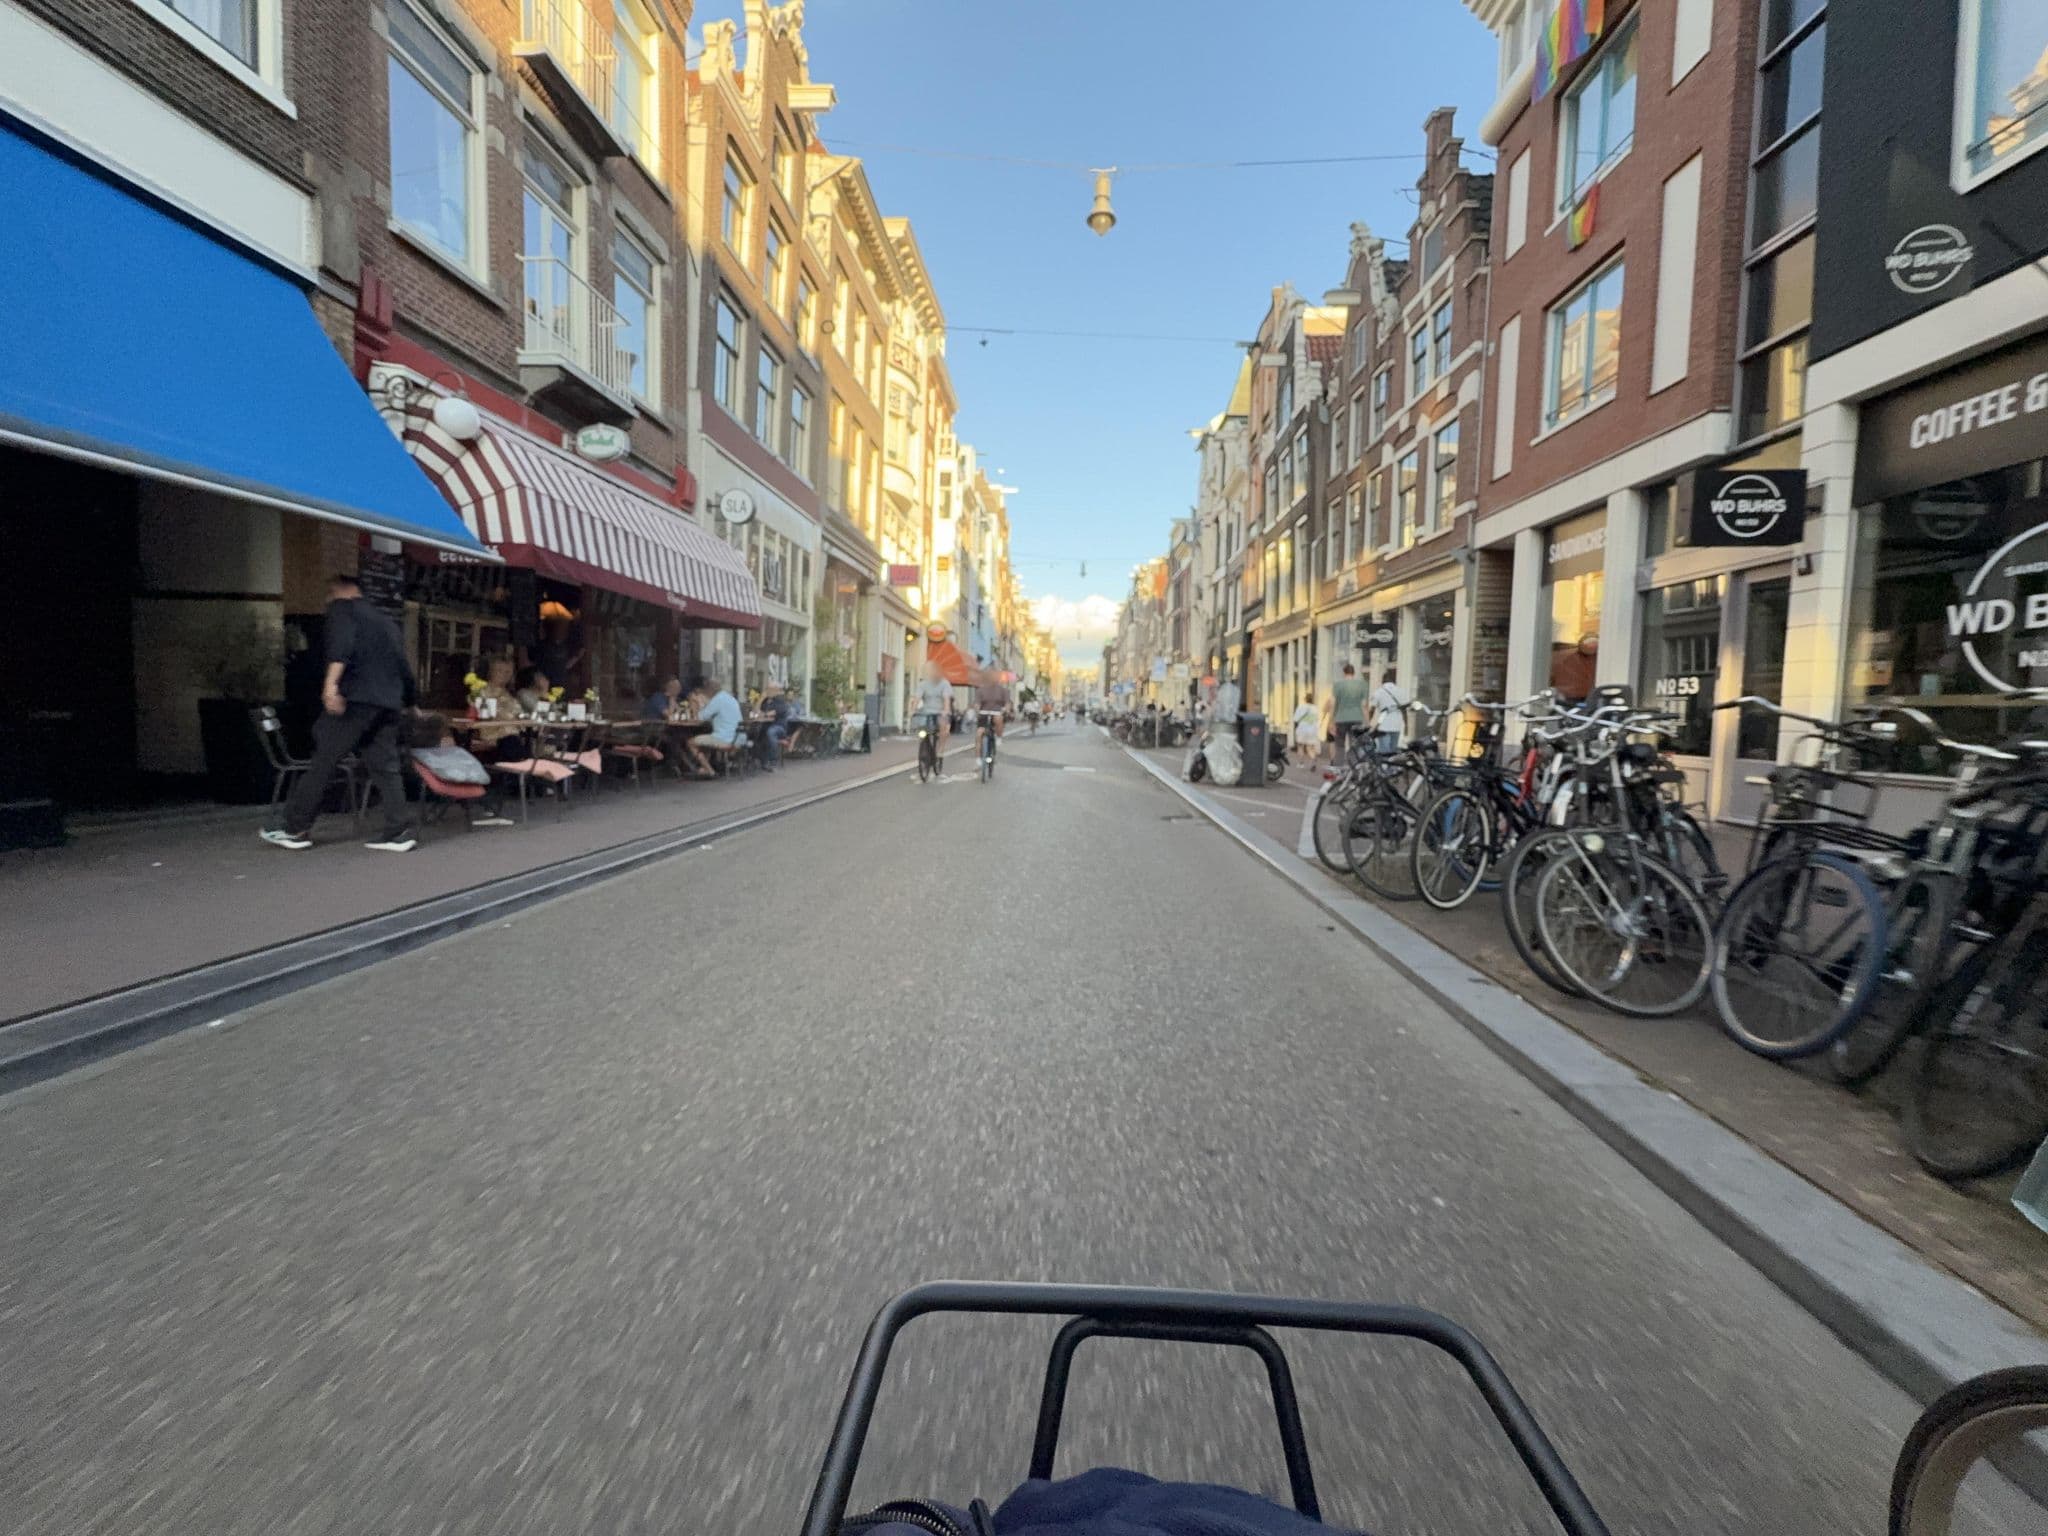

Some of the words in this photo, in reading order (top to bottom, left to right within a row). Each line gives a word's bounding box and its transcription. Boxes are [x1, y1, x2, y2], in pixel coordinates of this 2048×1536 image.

[1909, 381, 2021, 449] COFFEE
[725, 498, 748, 513] SLA
[1710, 499, 1736, 514] WD
[1946, 598, 2016, 636] WD
